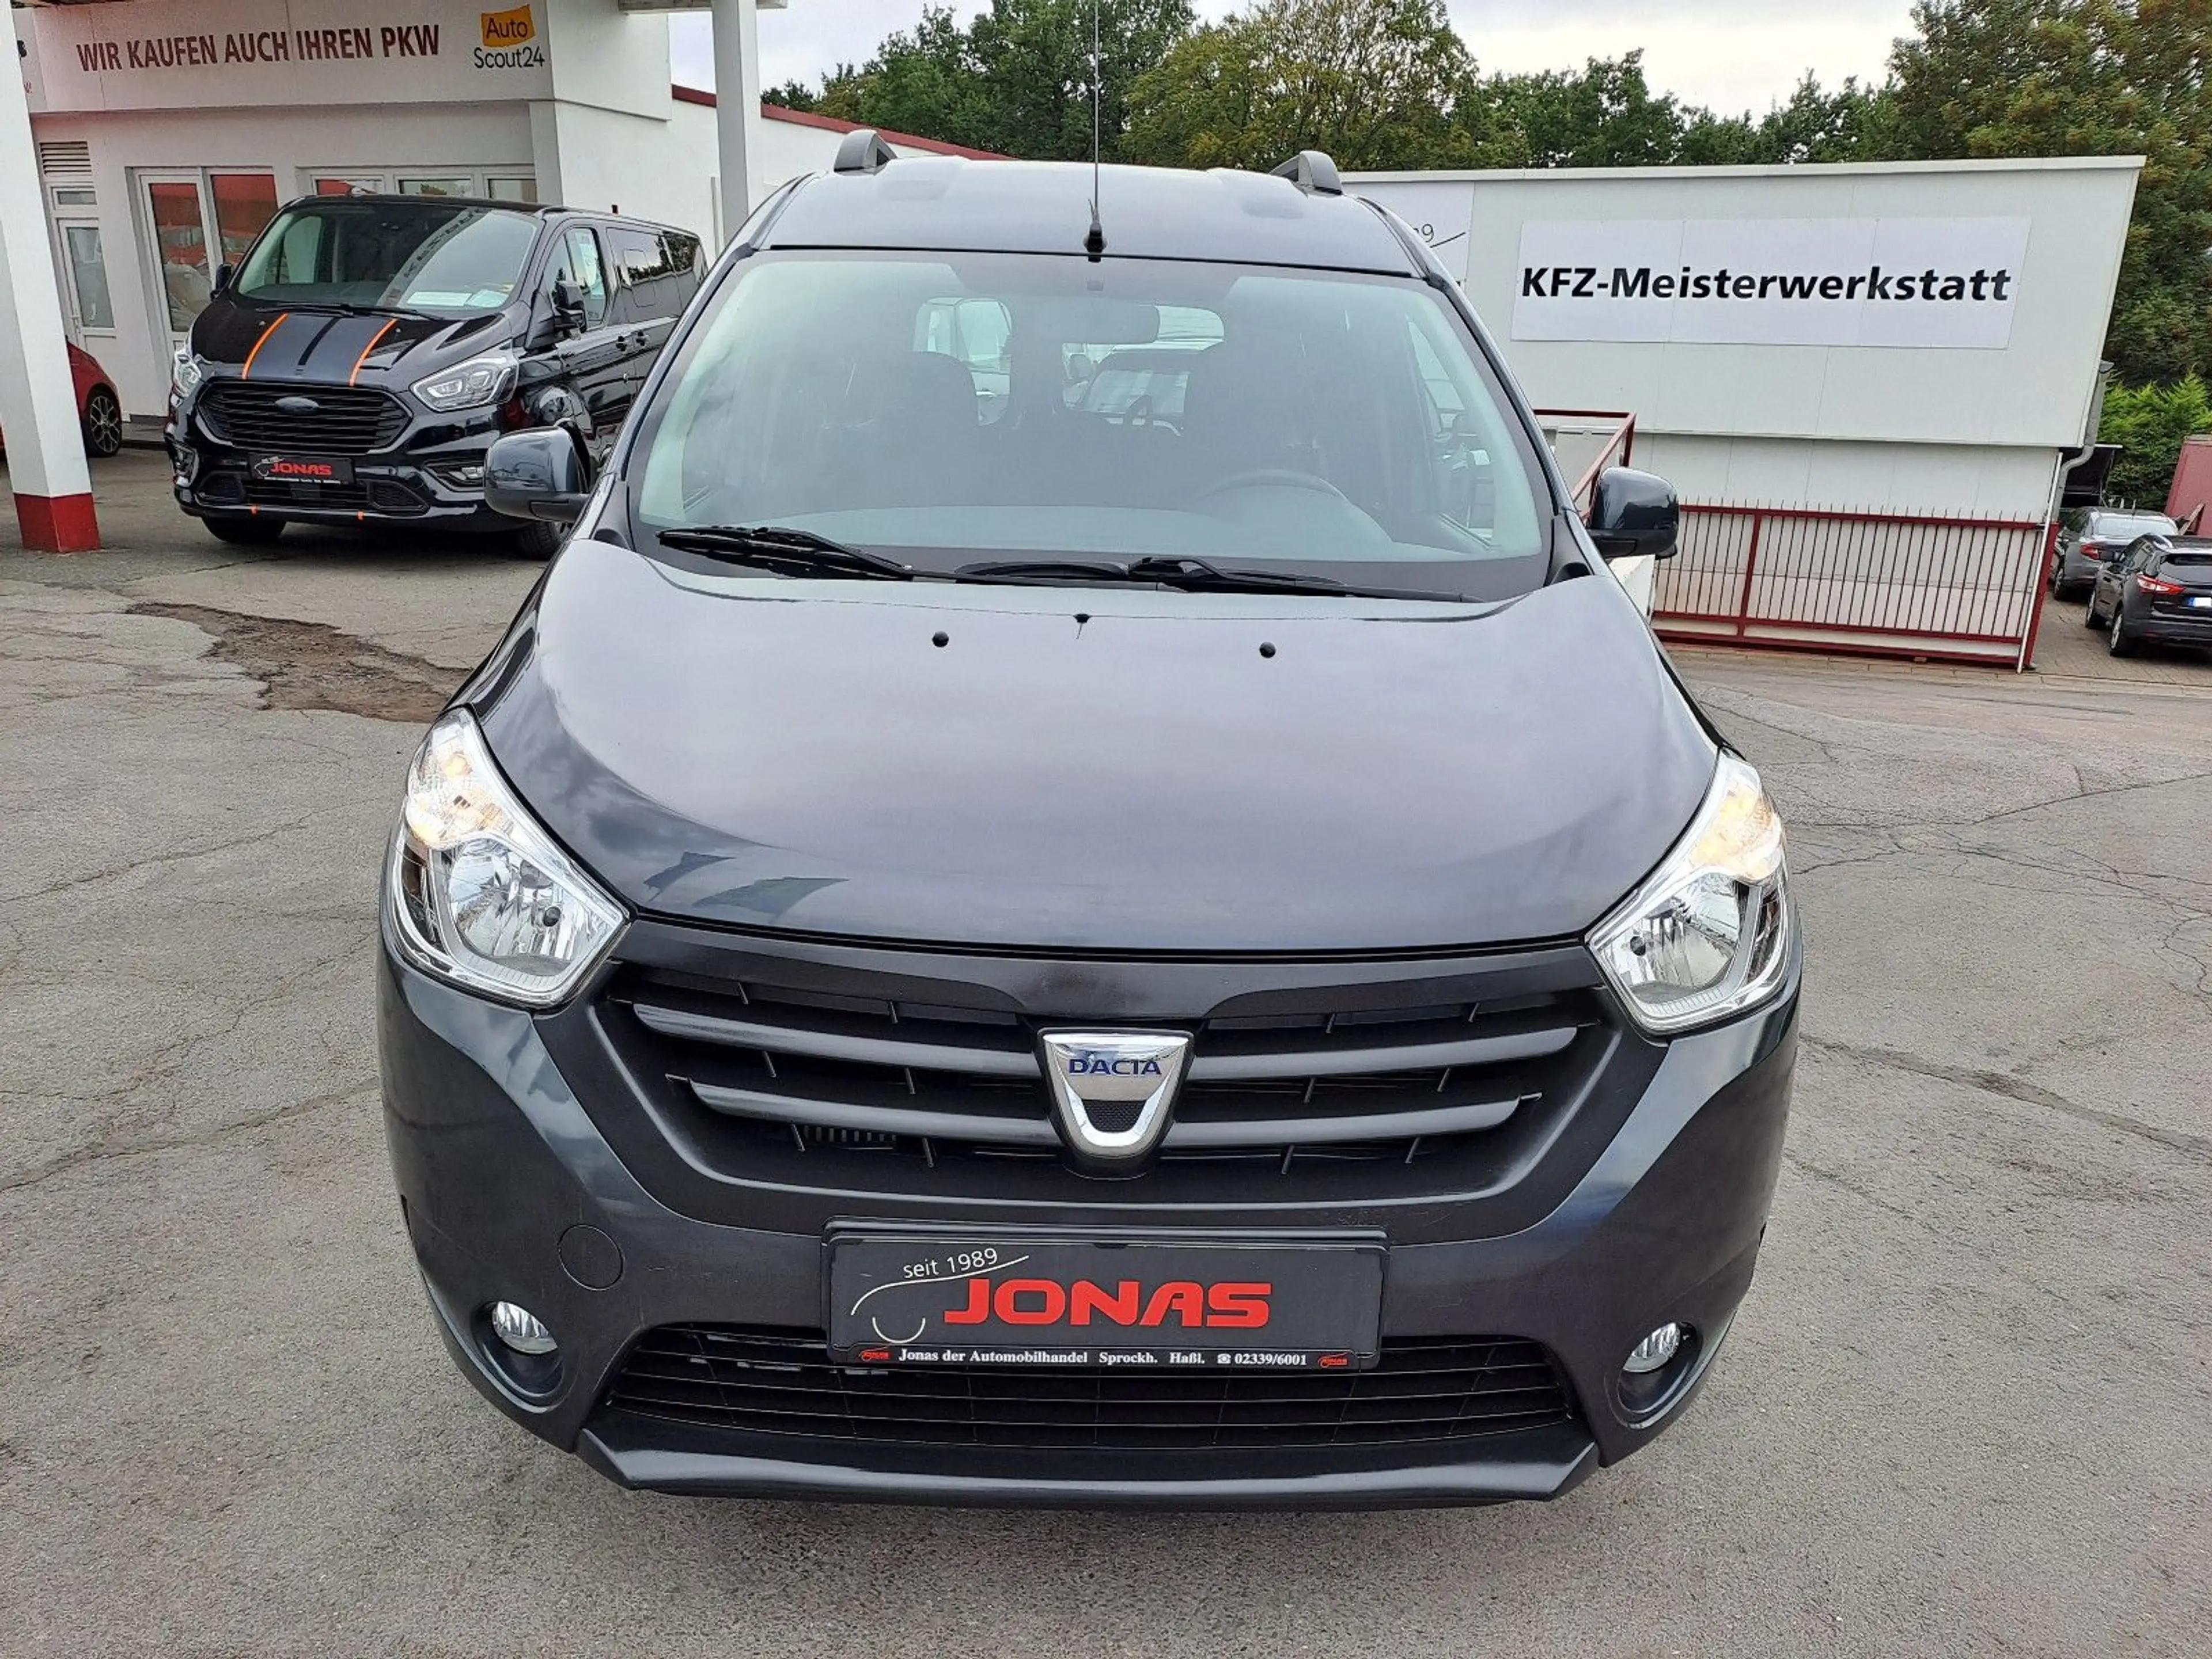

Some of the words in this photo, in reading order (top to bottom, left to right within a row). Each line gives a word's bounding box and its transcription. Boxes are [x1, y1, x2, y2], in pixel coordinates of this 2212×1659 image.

[486, 17, 529, 39] Auto
[76, 41, 122, 71] WIR
[127, 34, 218, 69] KAUFEN
[225, 31, 290, 63] AUCH
[296, 28, 372, 60] IHREN
[381, 24, 440, 58] PKW
[474, 46, 546, 69] Scout24
[1522, 266, 2012, 301] KFZ-Meisterwerkstatt
[270, 463, 332, 476] JONAS
[1069, 1059, 1162, 1075] DACIA
[903, 1259, 939, 1278] seit
[947, 1248, 998, 1273] 1989
[944, 1278, 1272, 1328] JONAS
[899, 1348, 938, 1362] Jonas
[942, 1349, 966, 1362] der
[969, 1351, 1088, 1363] Automobilhandel
[1099, 1351, 1158, 1365] Sprockh.
[1169, 1352, 1205, 1365] Haßl.
[1234, 1354, 1307, 1366] 02339/6001
